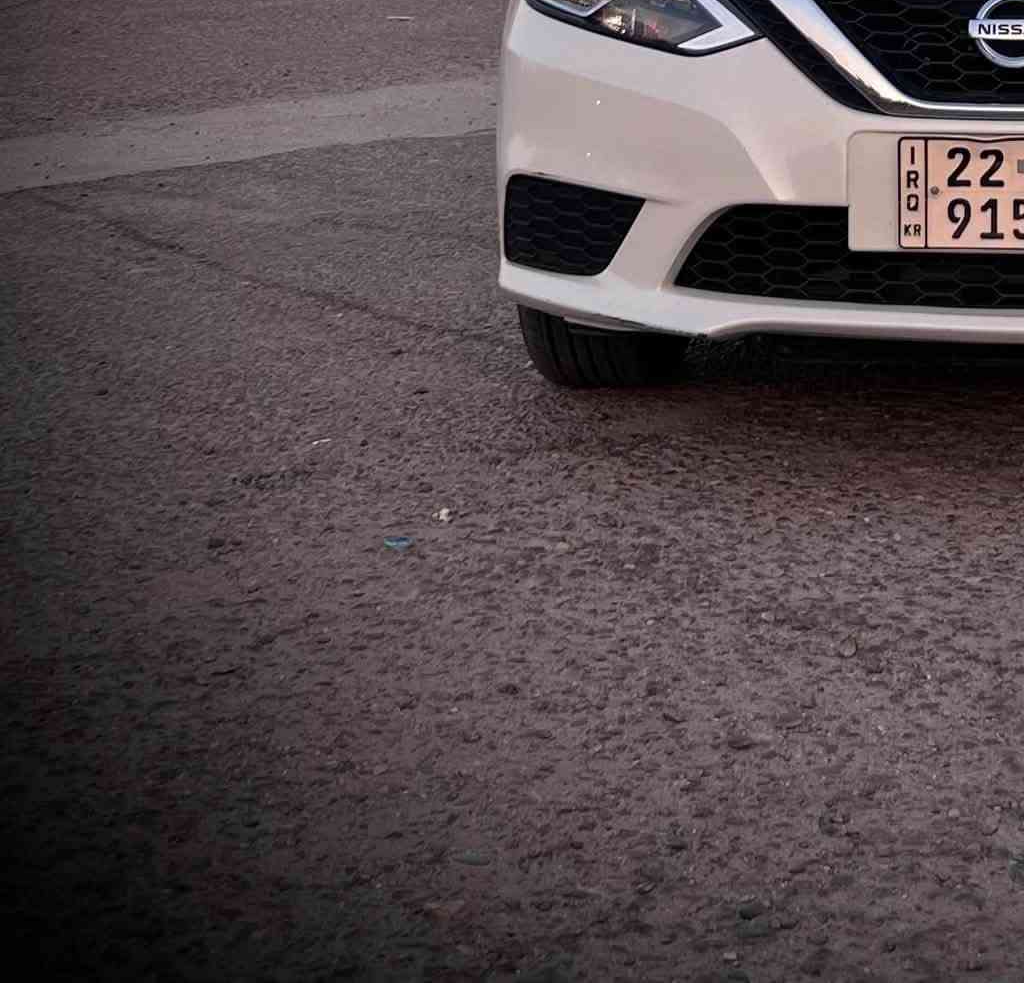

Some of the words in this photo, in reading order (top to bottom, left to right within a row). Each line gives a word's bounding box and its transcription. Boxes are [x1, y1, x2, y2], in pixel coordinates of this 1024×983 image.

[905, 145, 920, 212] IRQ
[946, 147, 1005, 188] 22
[903, 223, 922, 237] KR
